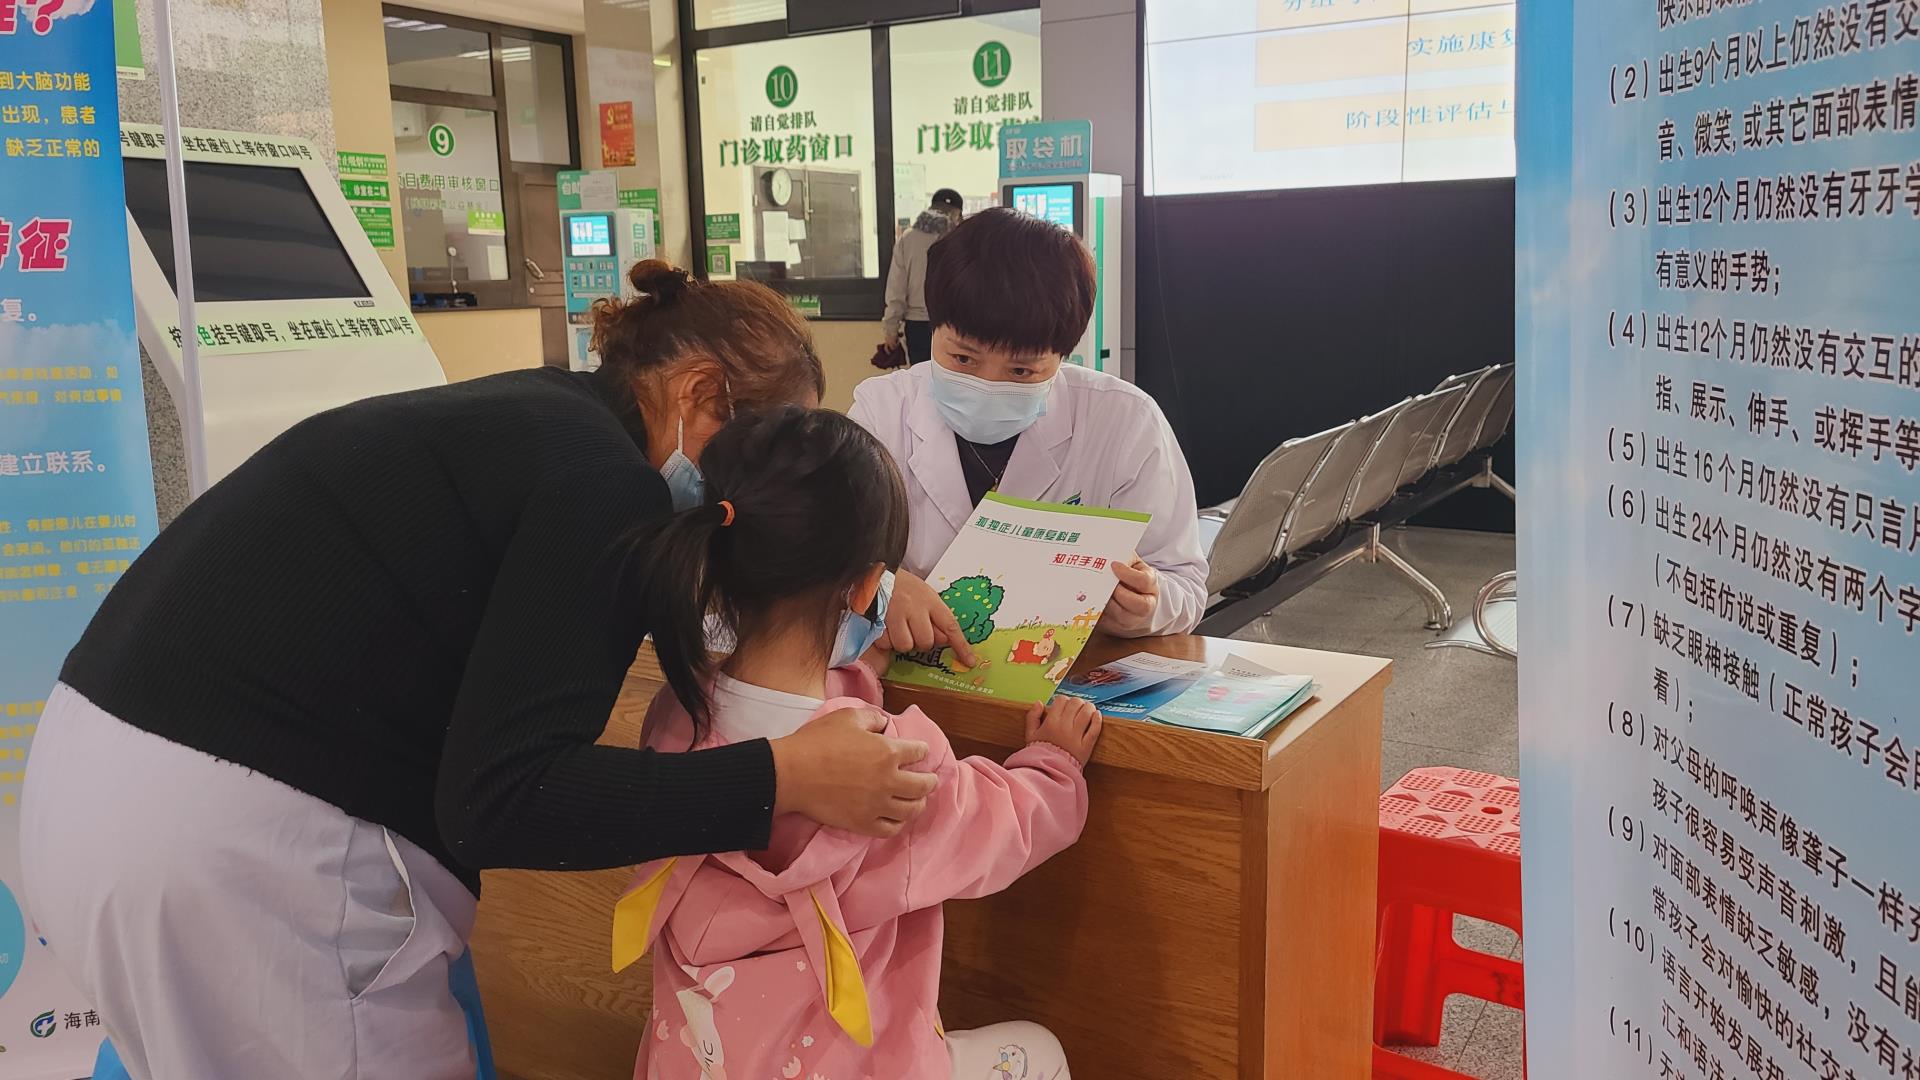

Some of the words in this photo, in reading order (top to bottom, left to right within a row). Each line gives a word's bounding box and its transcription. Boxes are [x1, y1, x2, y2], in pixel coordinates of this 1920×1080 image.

[980, 49, 1006, 81] 11
[0, 71, 91, 91] 到大脑功能
[770, 72, 795, 102] 10
[954, 91, 1033, 115] 请自觉排队
[750, 111, 817, 132] 请自觉排队
[5, 137, 101, 158] 缺乏正常的
[435, 128, 450, 154] 9
[719, 133, 853, 168] 门诊取药窗口
[1006, 135, 1084, 160] 取袋机
[1656, 249, 1782, 296] 有意义的手势；
[0, 450, 106, 476] 建立联系。
[975, 515, 1081, 543] 孤独症儿童康复科普
[1052, 552, 1108, 570] 知识手册
[64, 1009, 100, 1029] 海南
